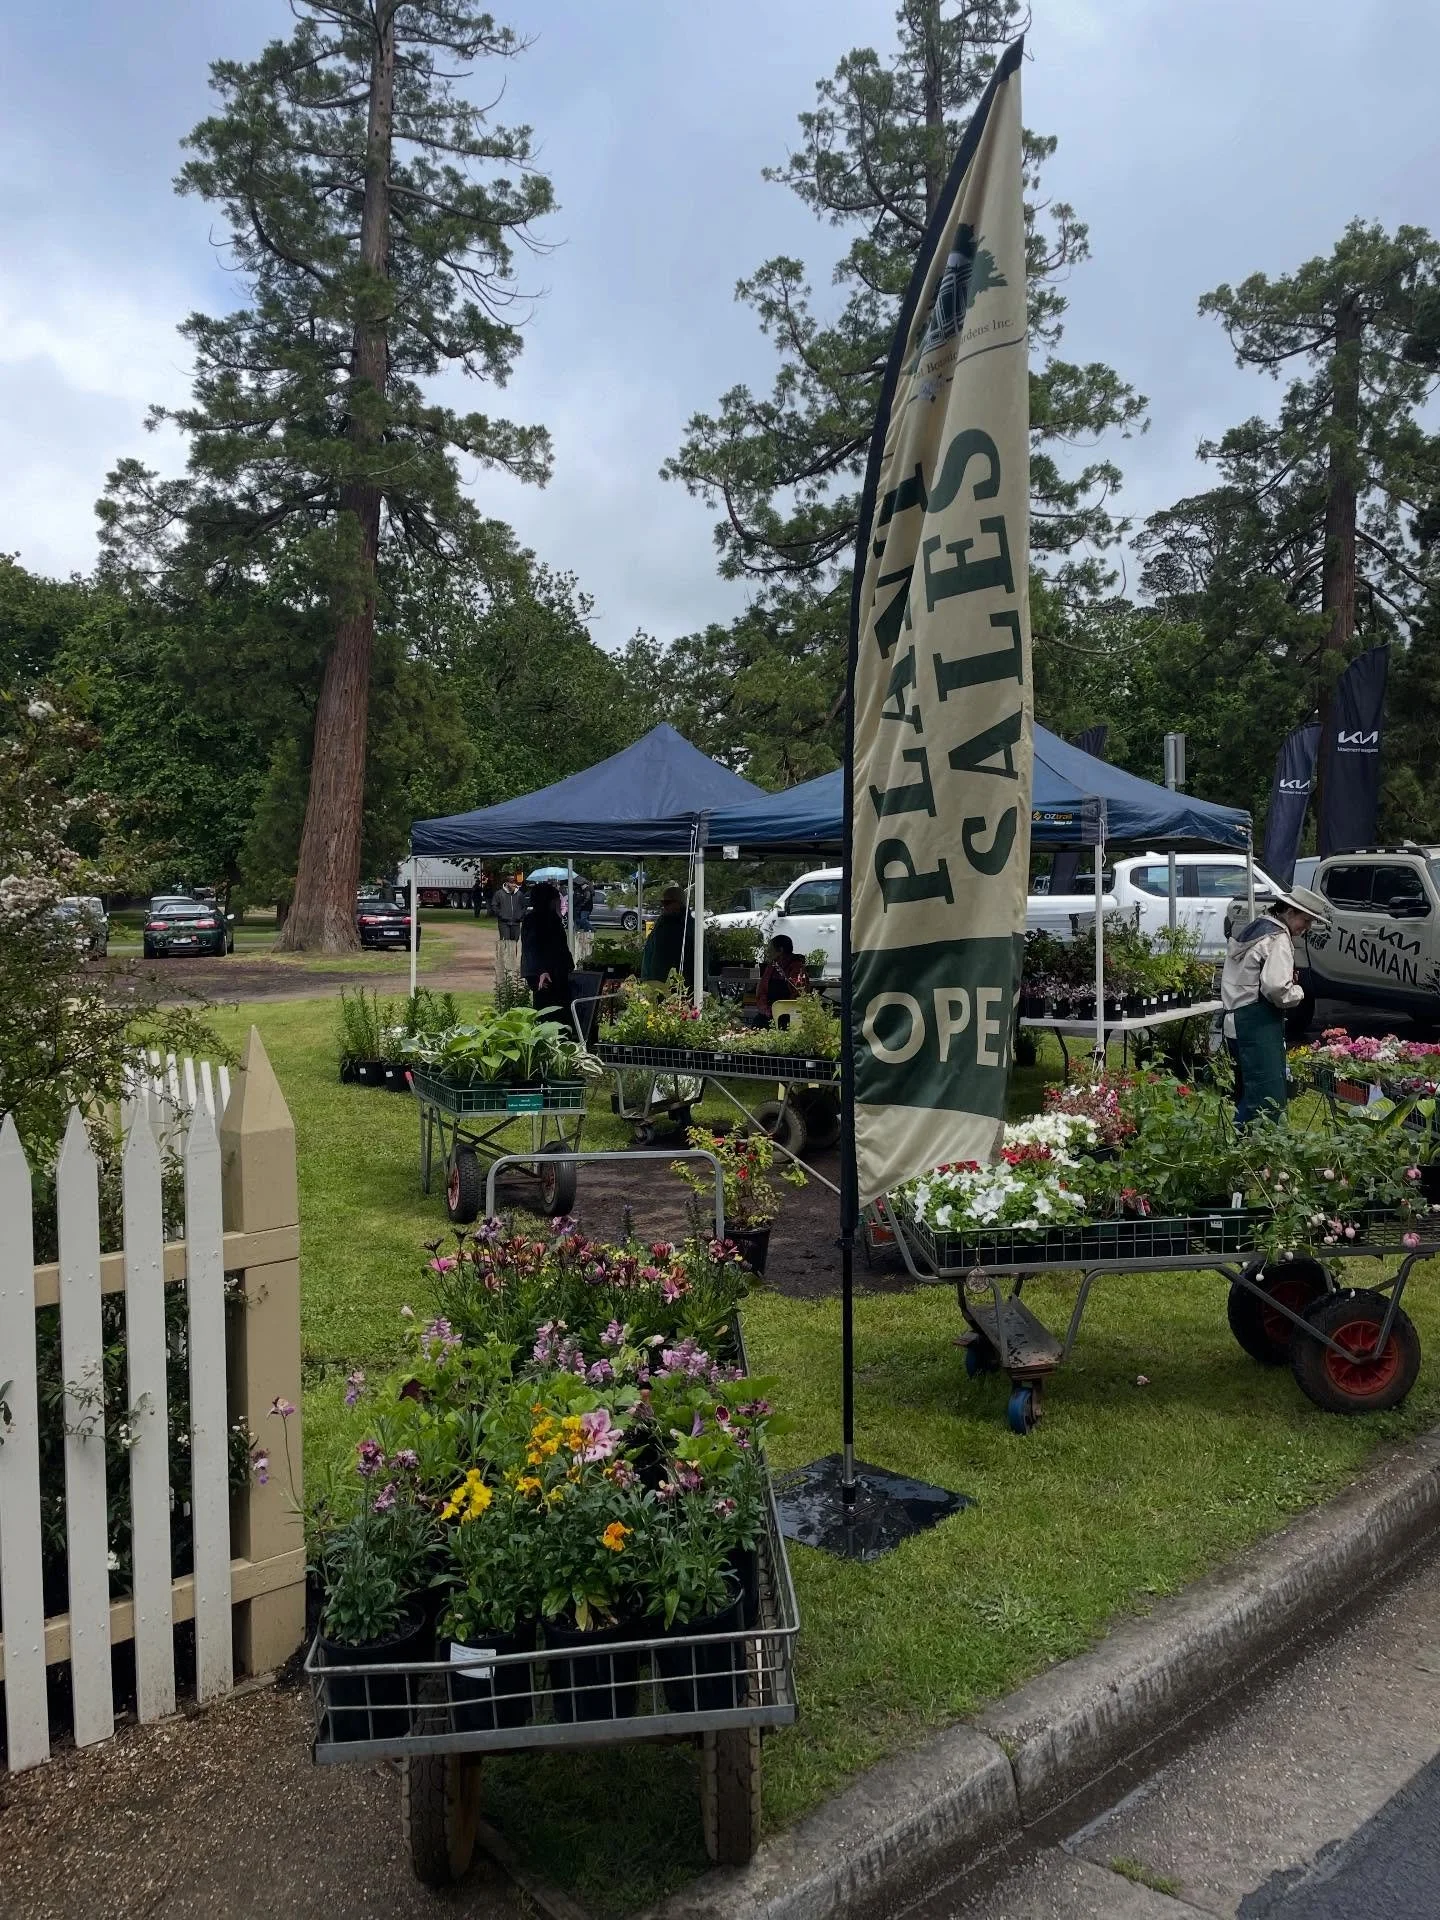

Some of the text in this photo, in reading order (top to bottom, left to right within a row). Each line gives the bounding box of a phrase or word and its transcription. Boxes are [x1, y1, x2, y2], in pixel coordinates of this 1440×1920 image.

[992, 318, 1014, 330] Inc.
[922, 427, 1024, 877] SALES
[872, 461, 955, 914] PLANT
[1337, 730, 1379, 745] KIA
[1279, 778, 1311, 789] KIA
[1378, 925, 1421, 956] KIA
[1337, 926, 1418, 987] TASMAN
